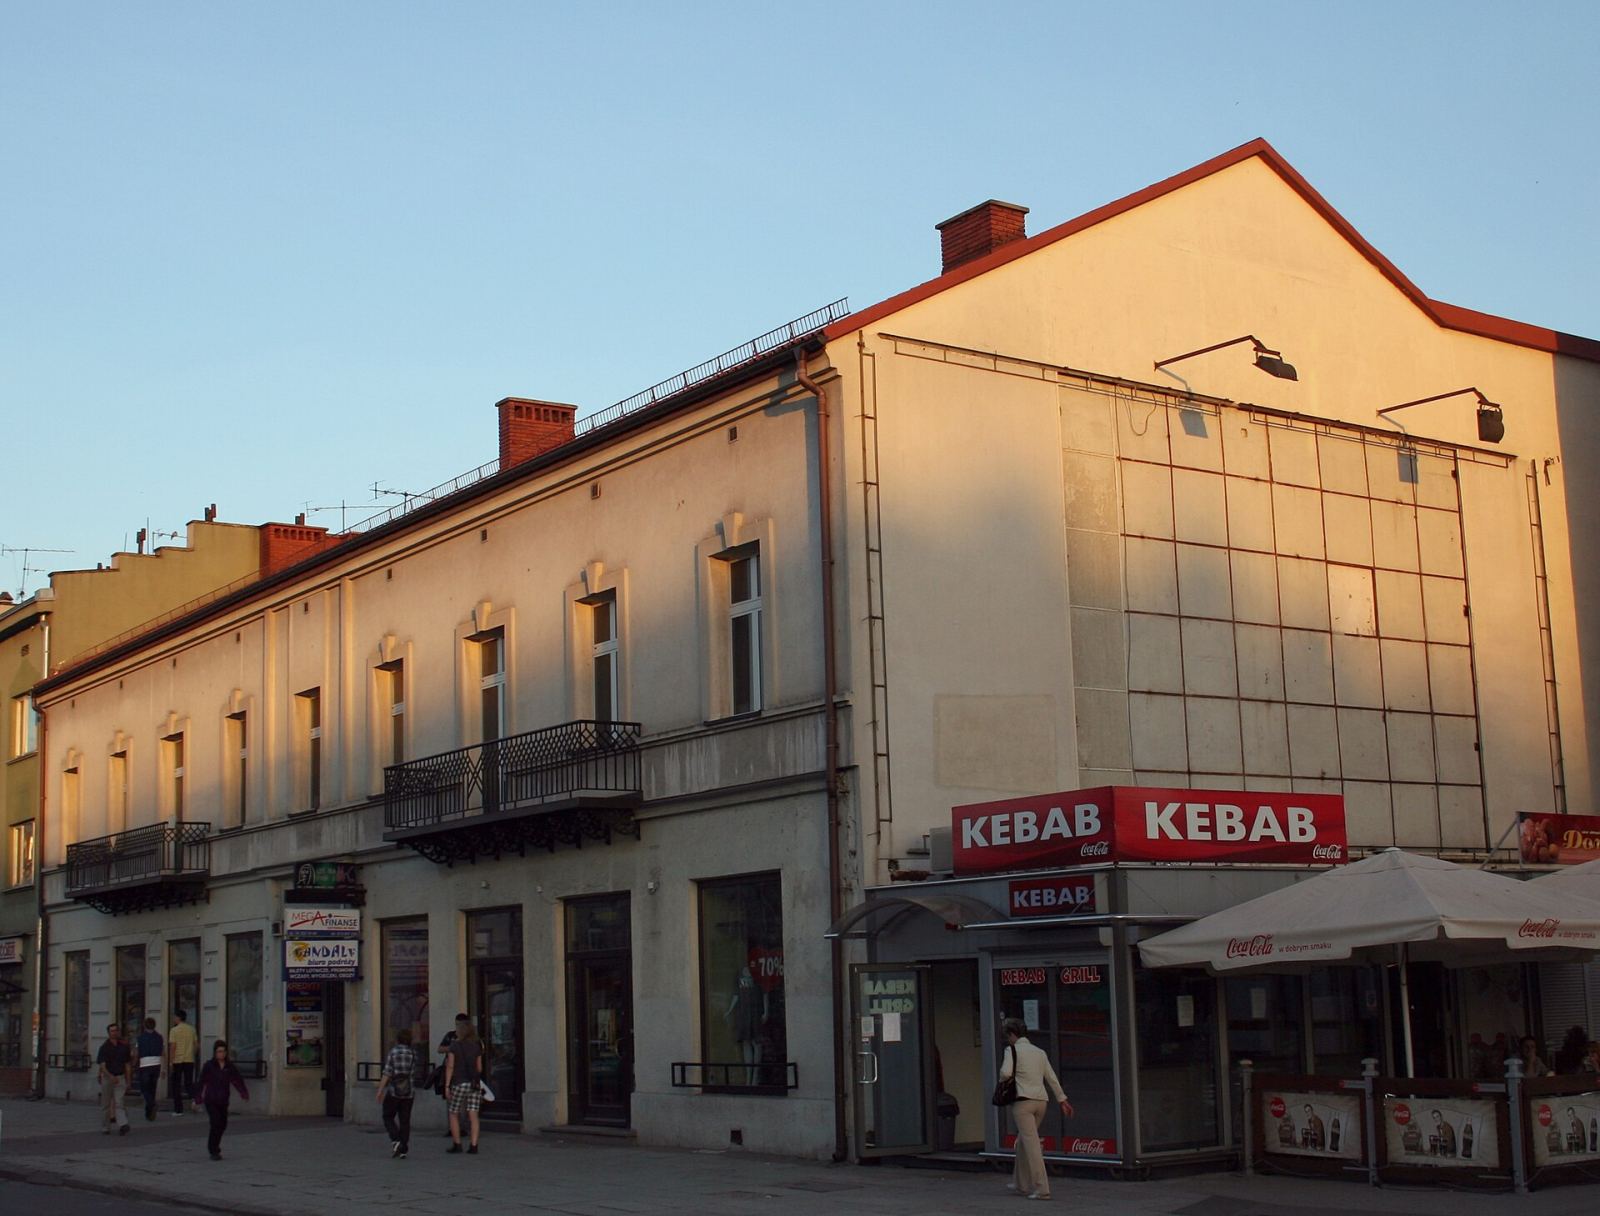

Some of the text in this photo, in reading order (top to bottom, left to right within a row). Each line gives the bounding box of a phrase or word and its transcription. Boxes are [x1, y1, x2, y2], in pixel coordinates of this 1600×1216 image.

[961, 803, 1102, 849] KEBAB
[1144, 801, 1317, 843] KEBAB
[1013, 885, 1090, 908] KEBAB
[324, 918, 358, 927] FINANSE
[1285, 944, 1309, 953] dobrym
[1310, 942, 1332, 950] smaku
[758, 956, 784, 977] 70%
[1001, 966, 1101, 986] KEBAB GRILL
